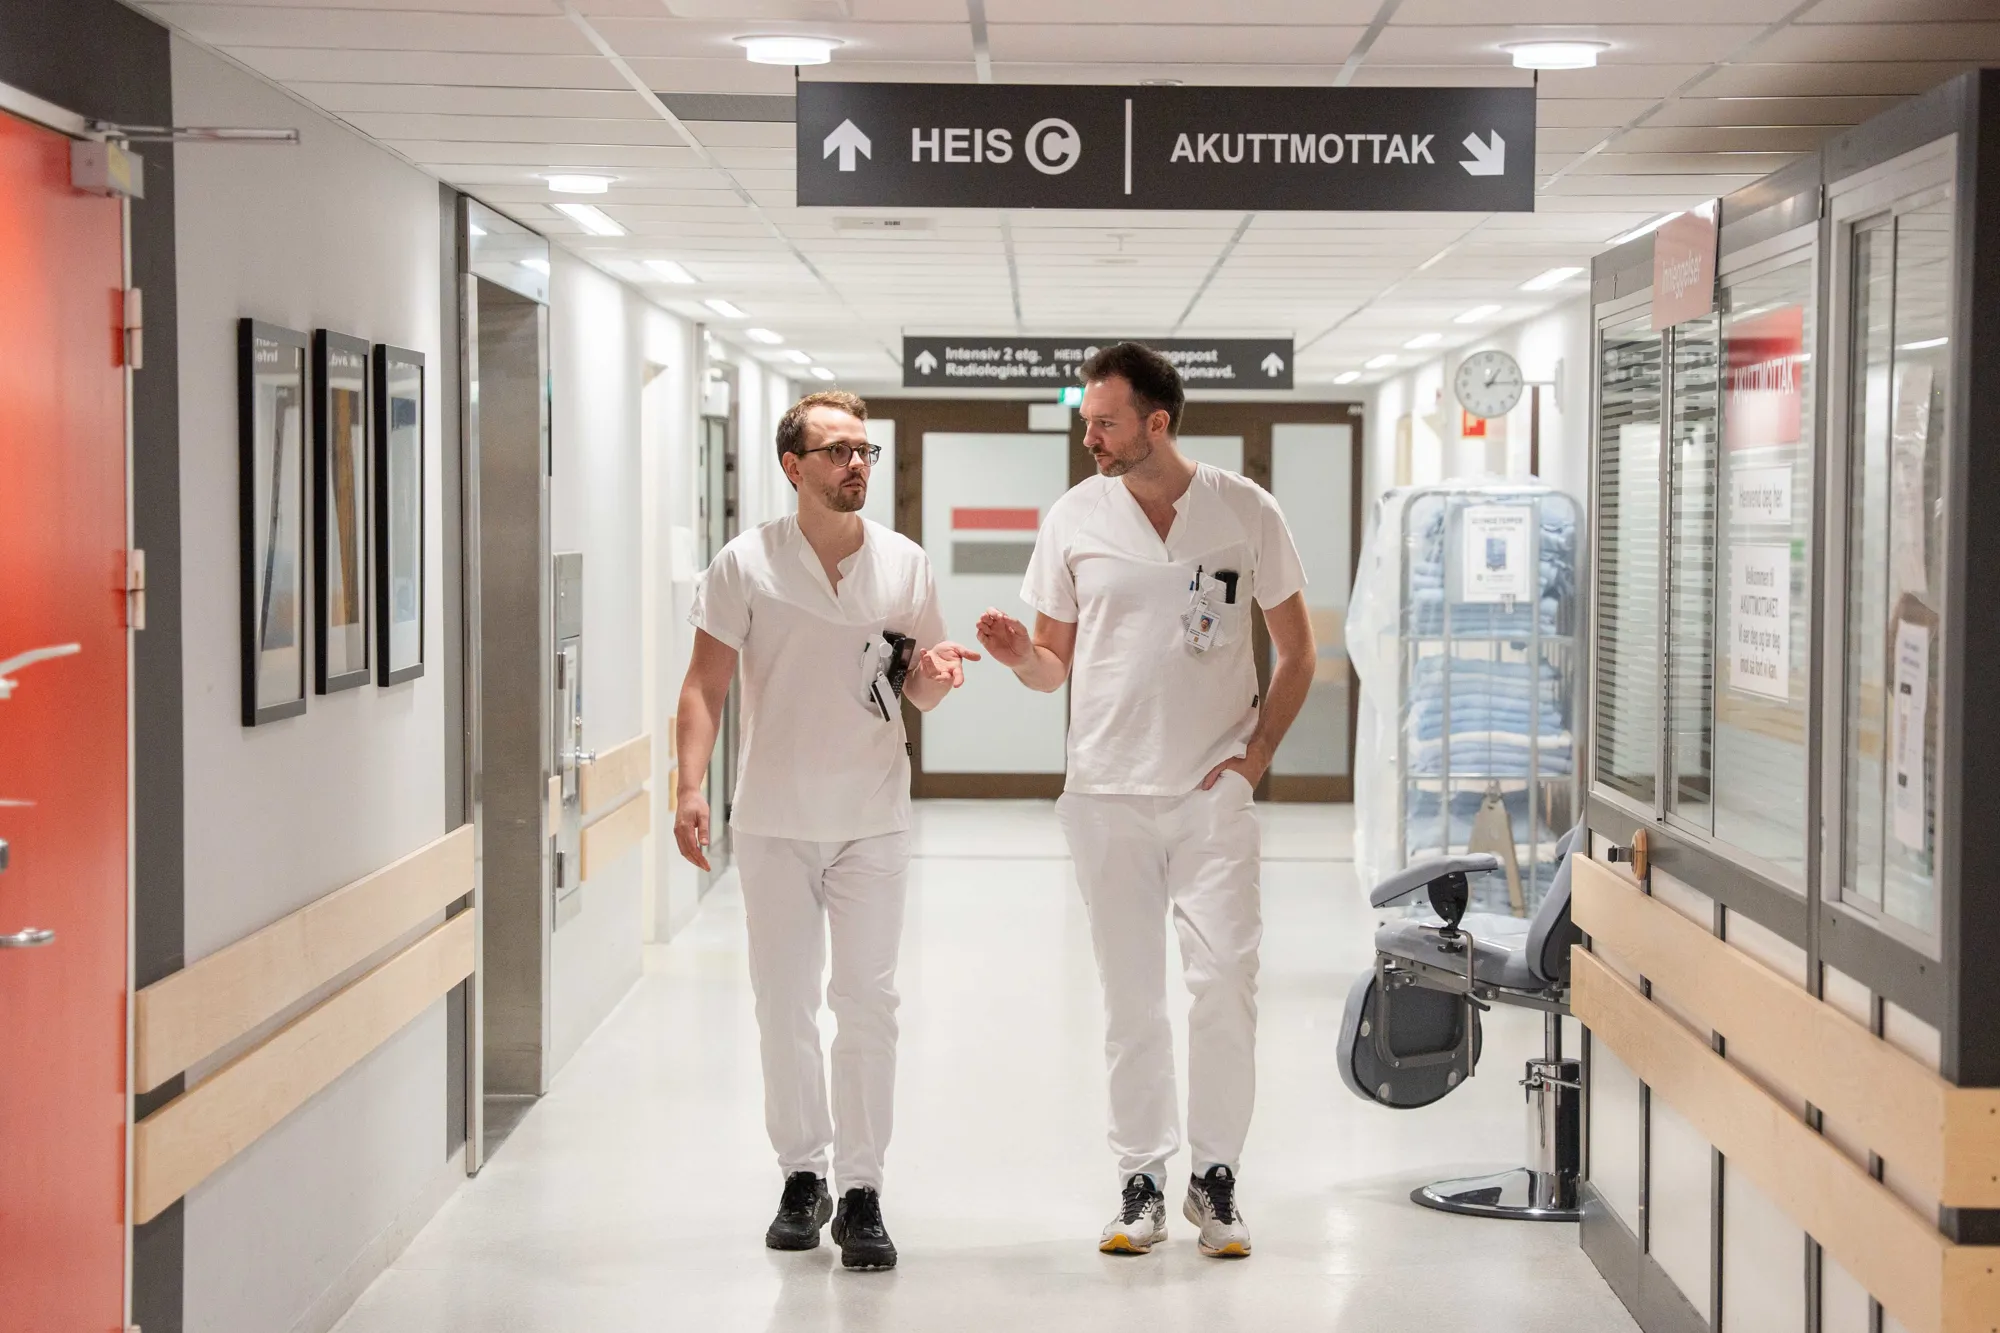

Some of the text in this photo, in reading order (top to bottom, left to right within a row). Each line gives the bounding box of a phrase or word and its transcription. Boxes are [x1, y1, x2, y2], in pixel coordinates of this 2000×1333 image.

[912, 124, 1072, 169] HEIS C
[1170, 133, 1435, 164] AKUTTMOTTAK
[945, 346, 1042, 364] Intensiv 2 etg.
[1054, 348, 1083, 361] HEIS
[945, 362, 1028, 380] Radiologisk
[1030, 363, 1060, 378] avd.
[1063, 363, 1071, 378] 1
[1733, 355, 1794, 406] AKUTTMOTTAK
